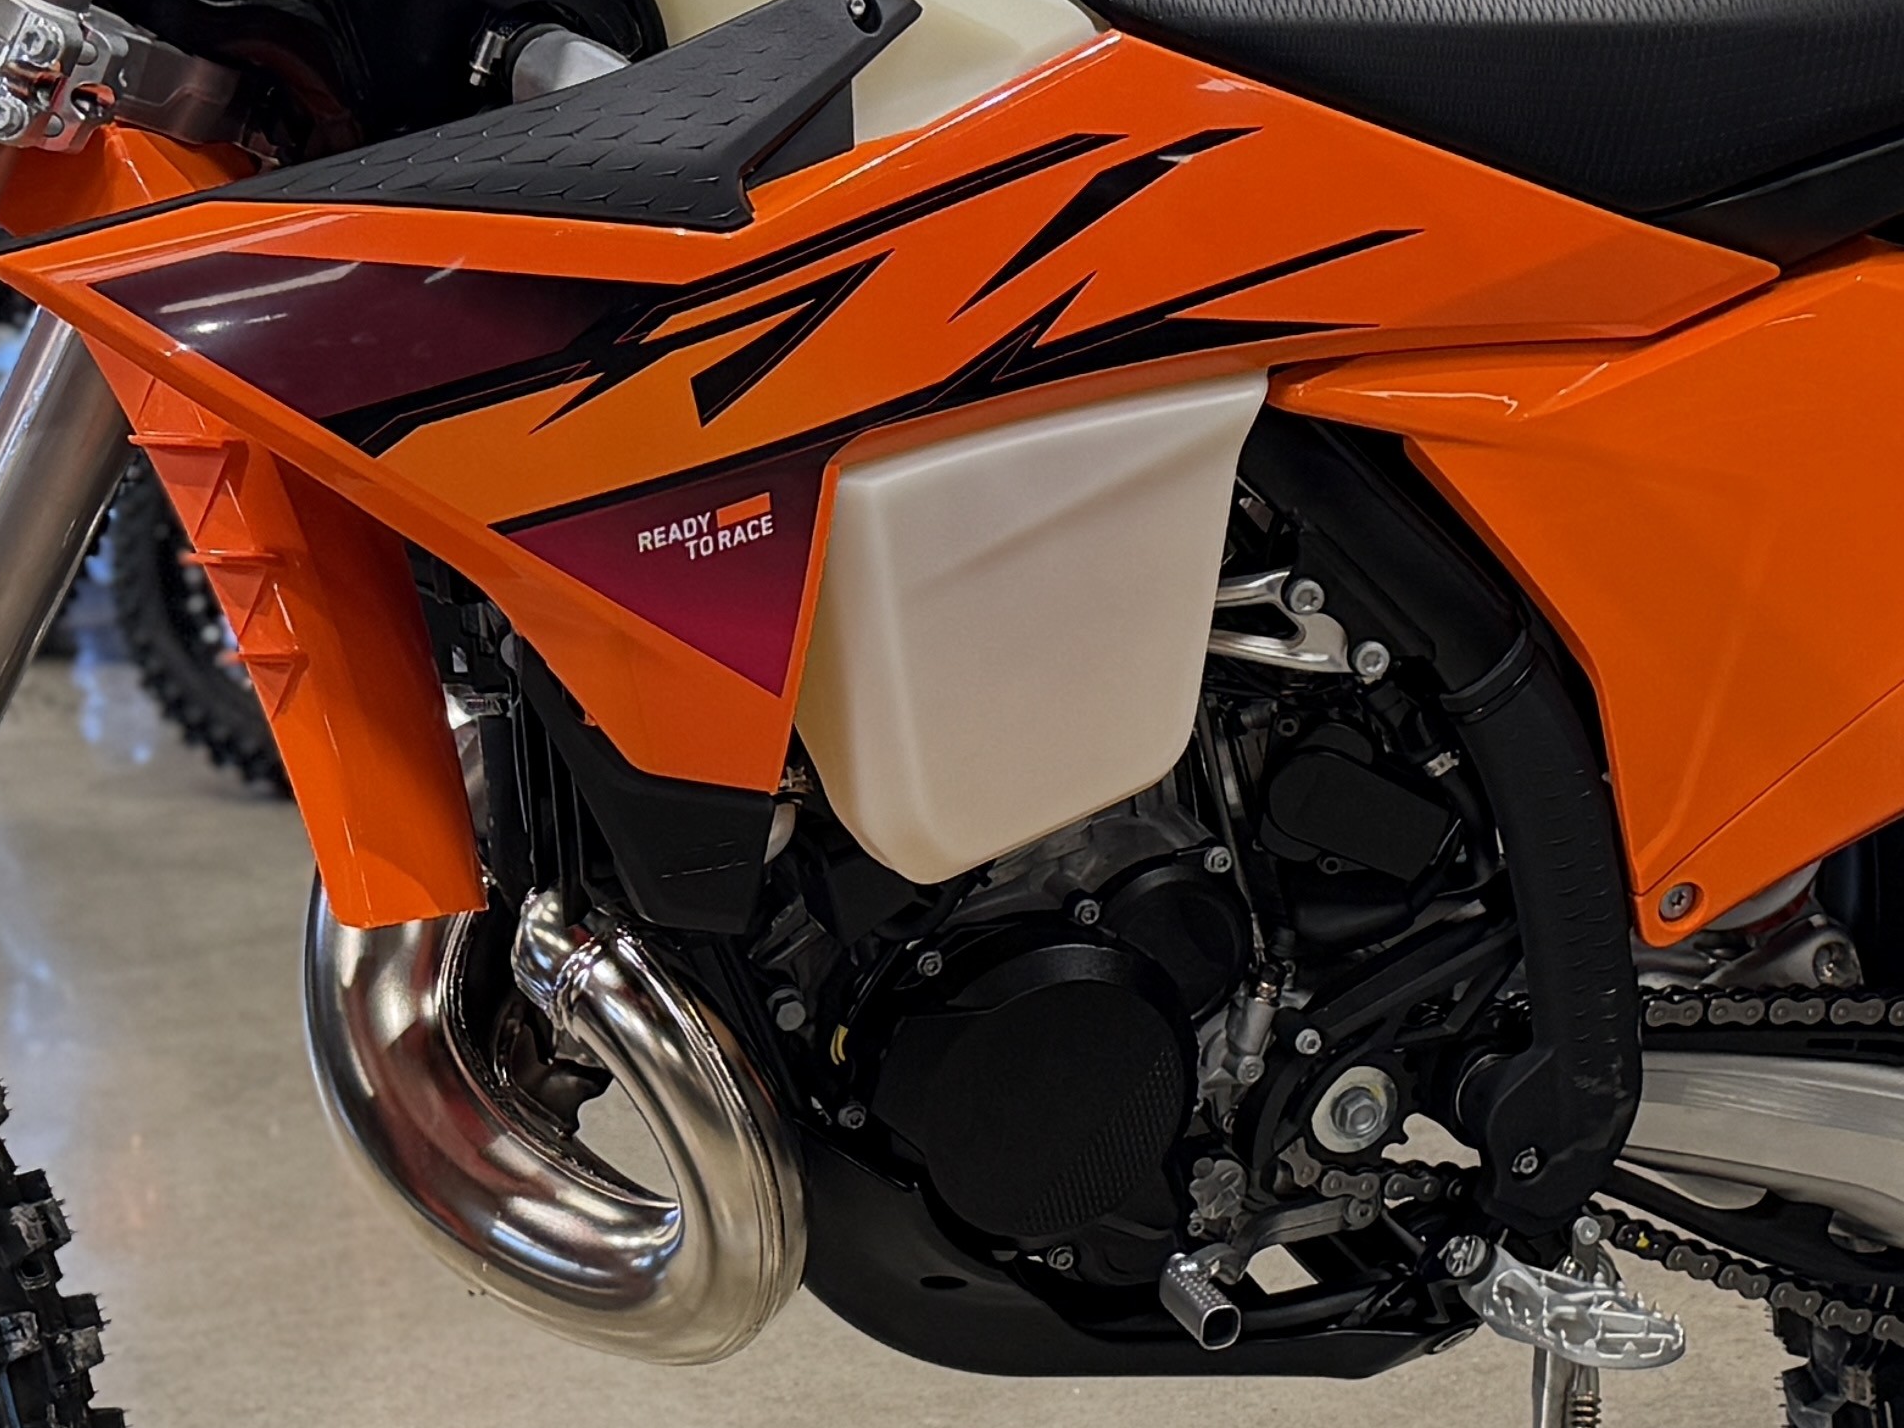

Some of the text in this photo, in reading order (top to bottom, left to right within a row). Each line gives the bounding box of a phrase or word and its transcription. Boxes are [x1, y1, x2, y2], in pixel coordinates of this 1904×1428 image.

[637, 511, 711, 553] READY
[684, 514, 774, 560] TO RACE
